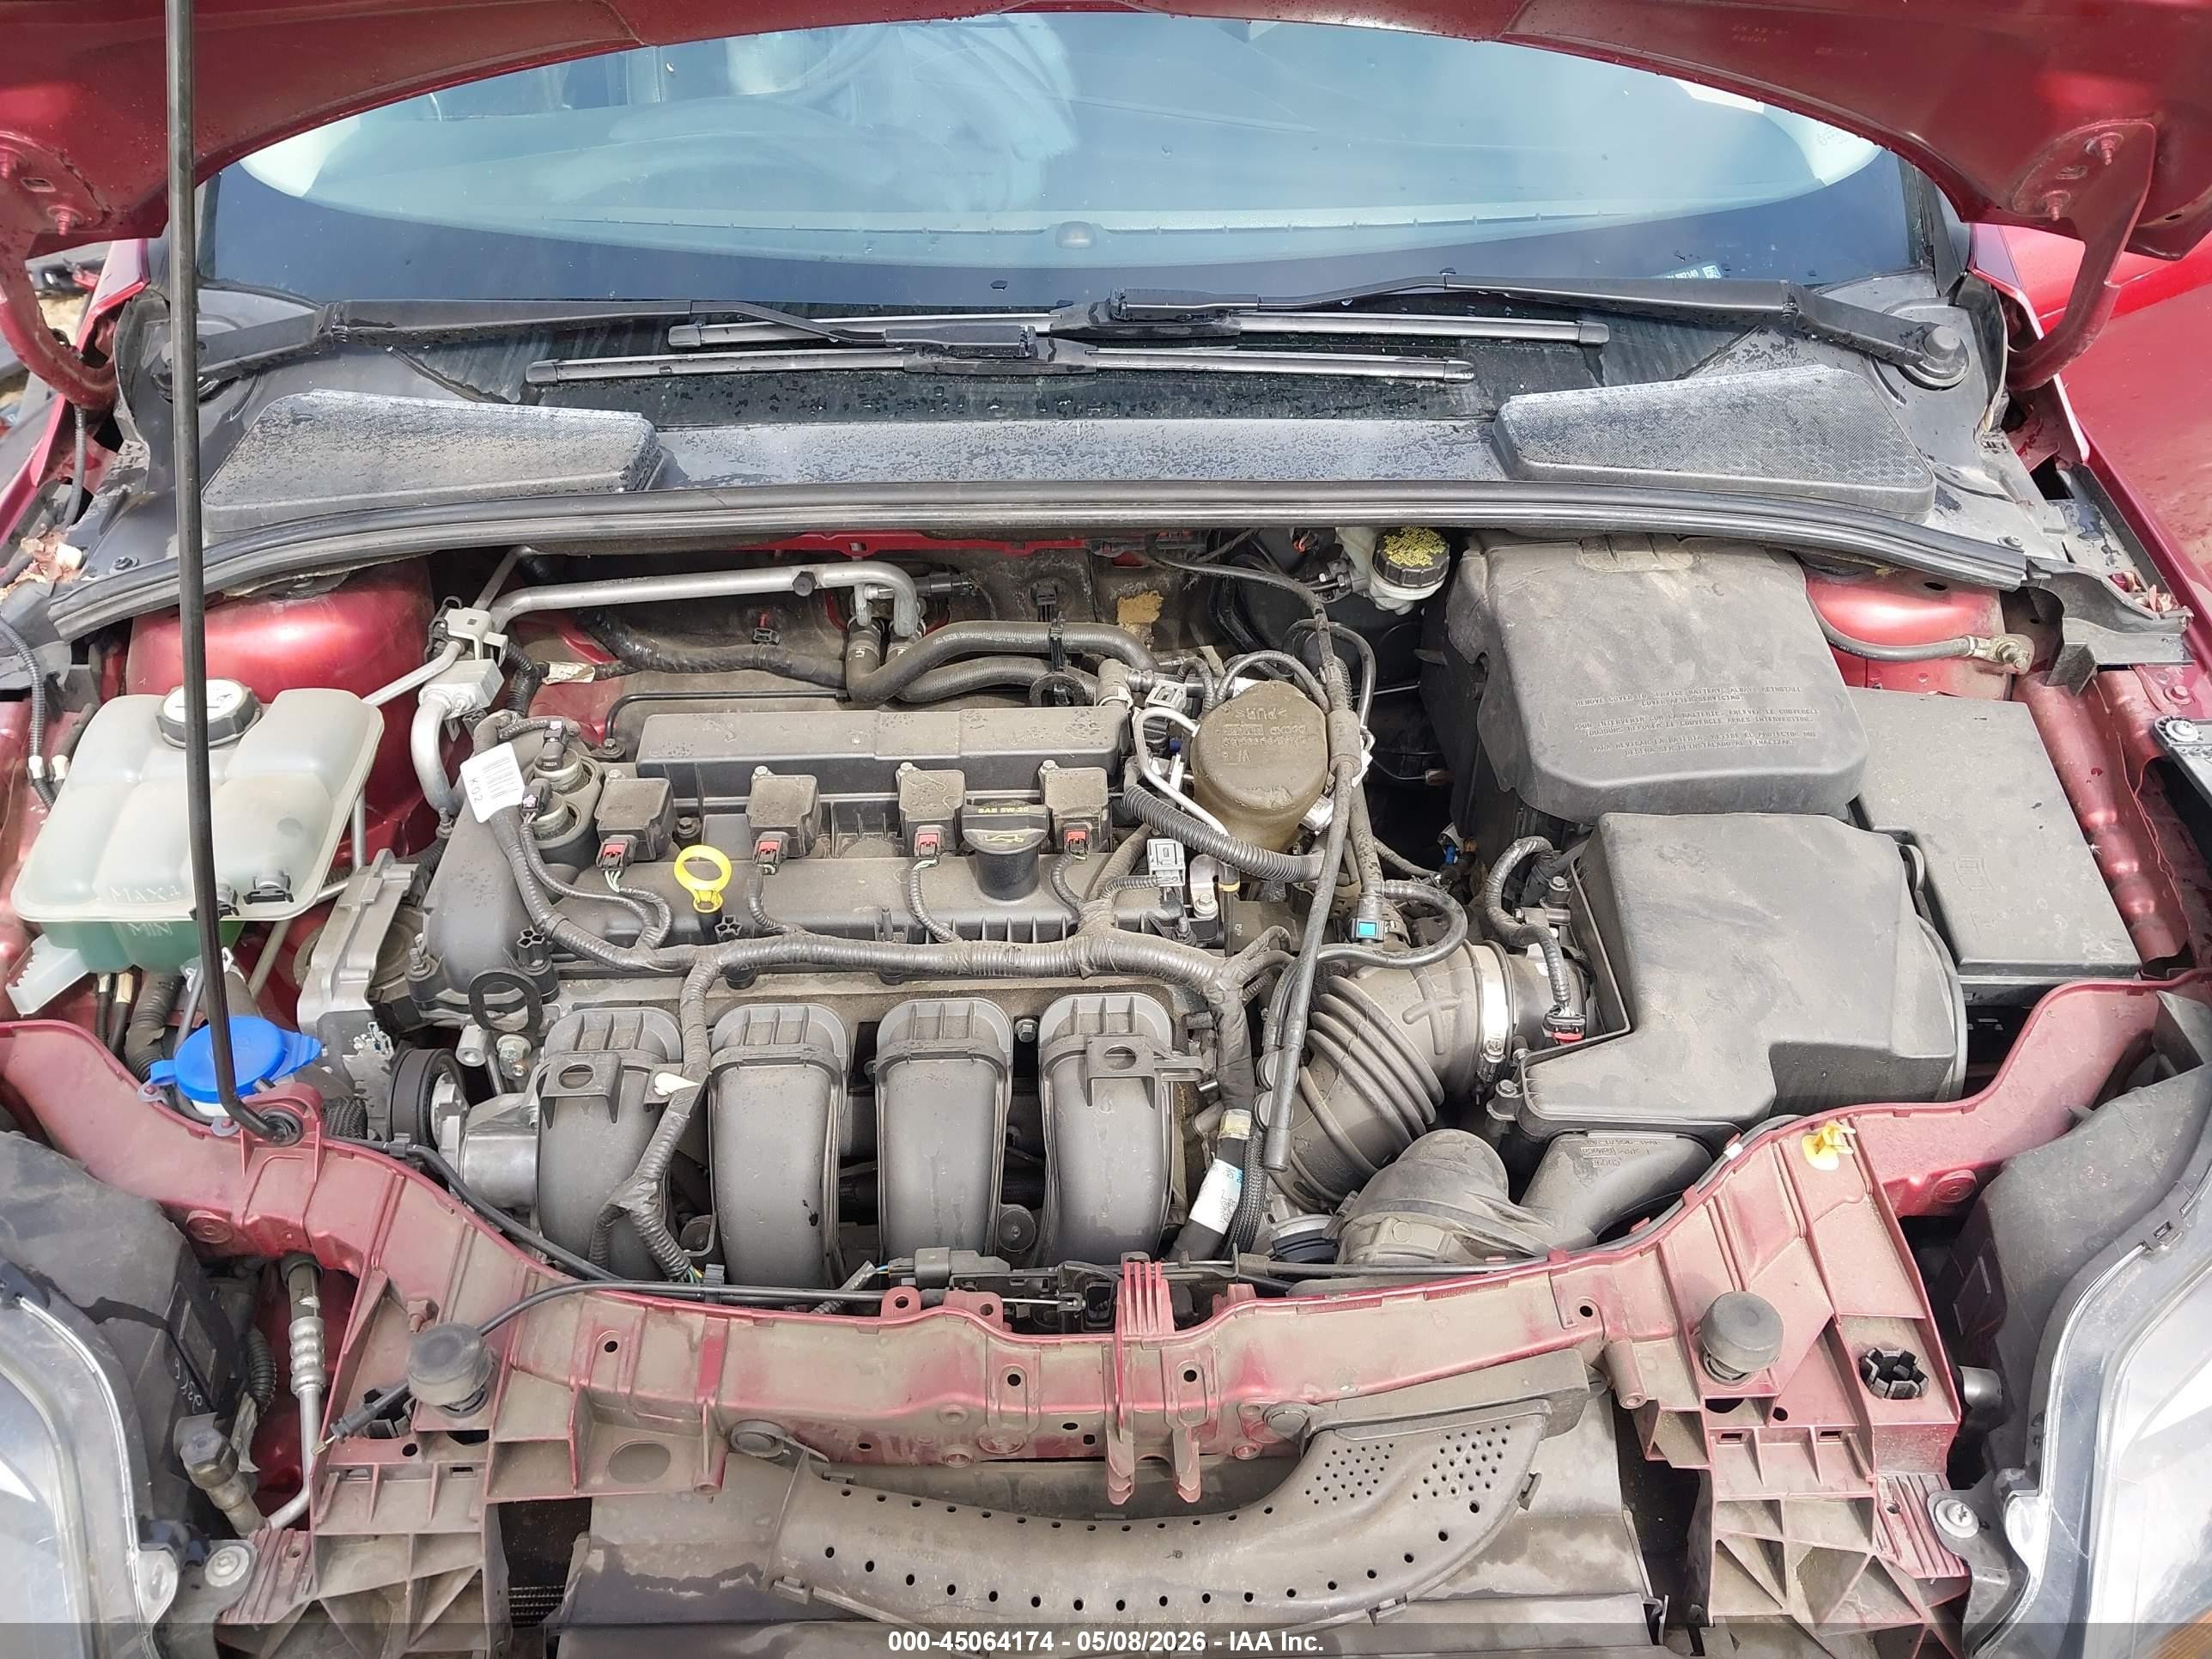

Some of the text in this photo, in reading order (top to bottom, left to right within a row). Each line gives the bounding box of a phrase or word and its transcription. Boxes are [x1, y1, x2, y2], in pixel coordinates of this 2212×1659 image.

[1575, 697, 1603, 707] REMOVE
[1608, 694, 1633, 703] COVER
[109, 885, 167, 902] MAX
[127, 922, 173, 938] MIN
